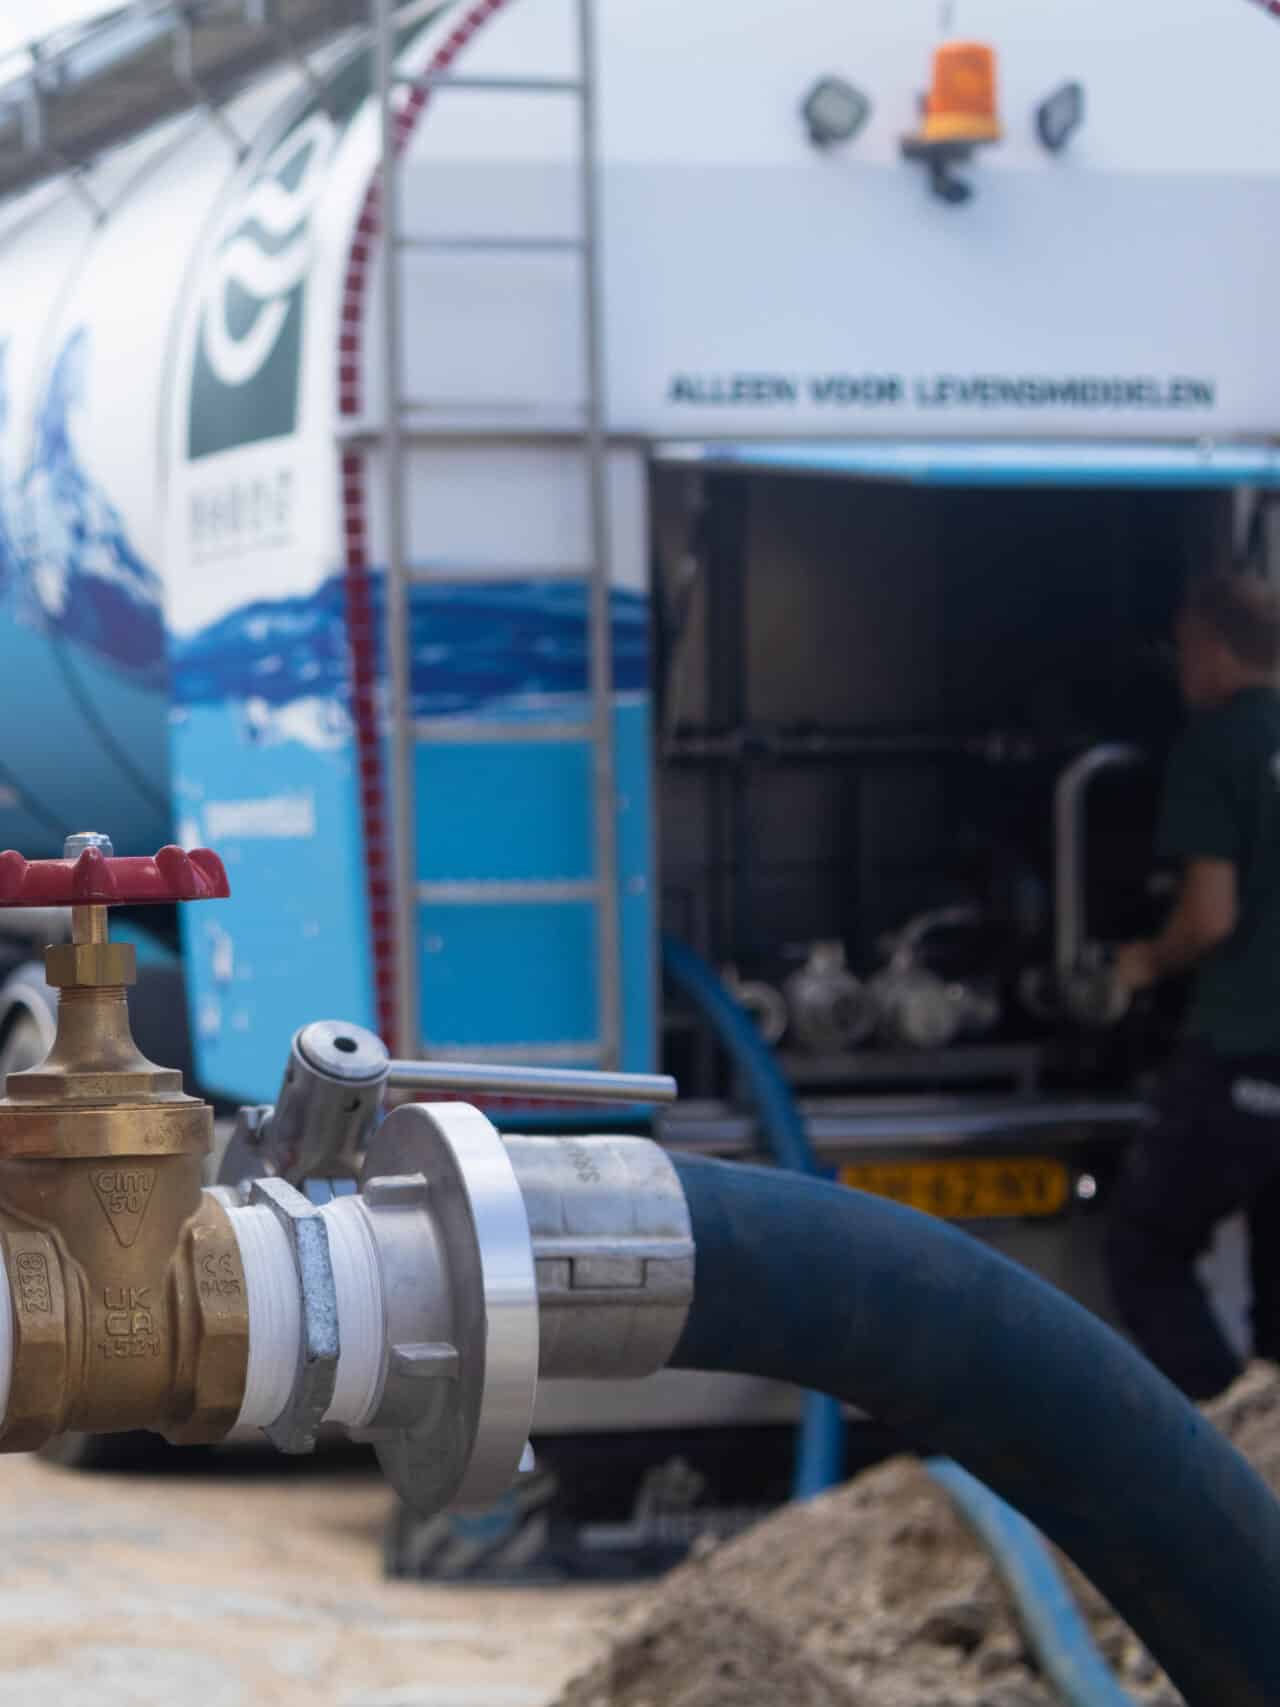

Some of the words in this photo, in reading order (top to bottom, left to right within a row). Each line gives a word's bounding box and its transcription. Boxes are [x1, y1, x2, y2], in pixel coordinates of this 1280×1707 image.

[669, 373, 795, 404] ALLEEN
[810, 375, 904, 406] VOOR
[919, 376, 1216, 410] LEVENSMIDDELEN
